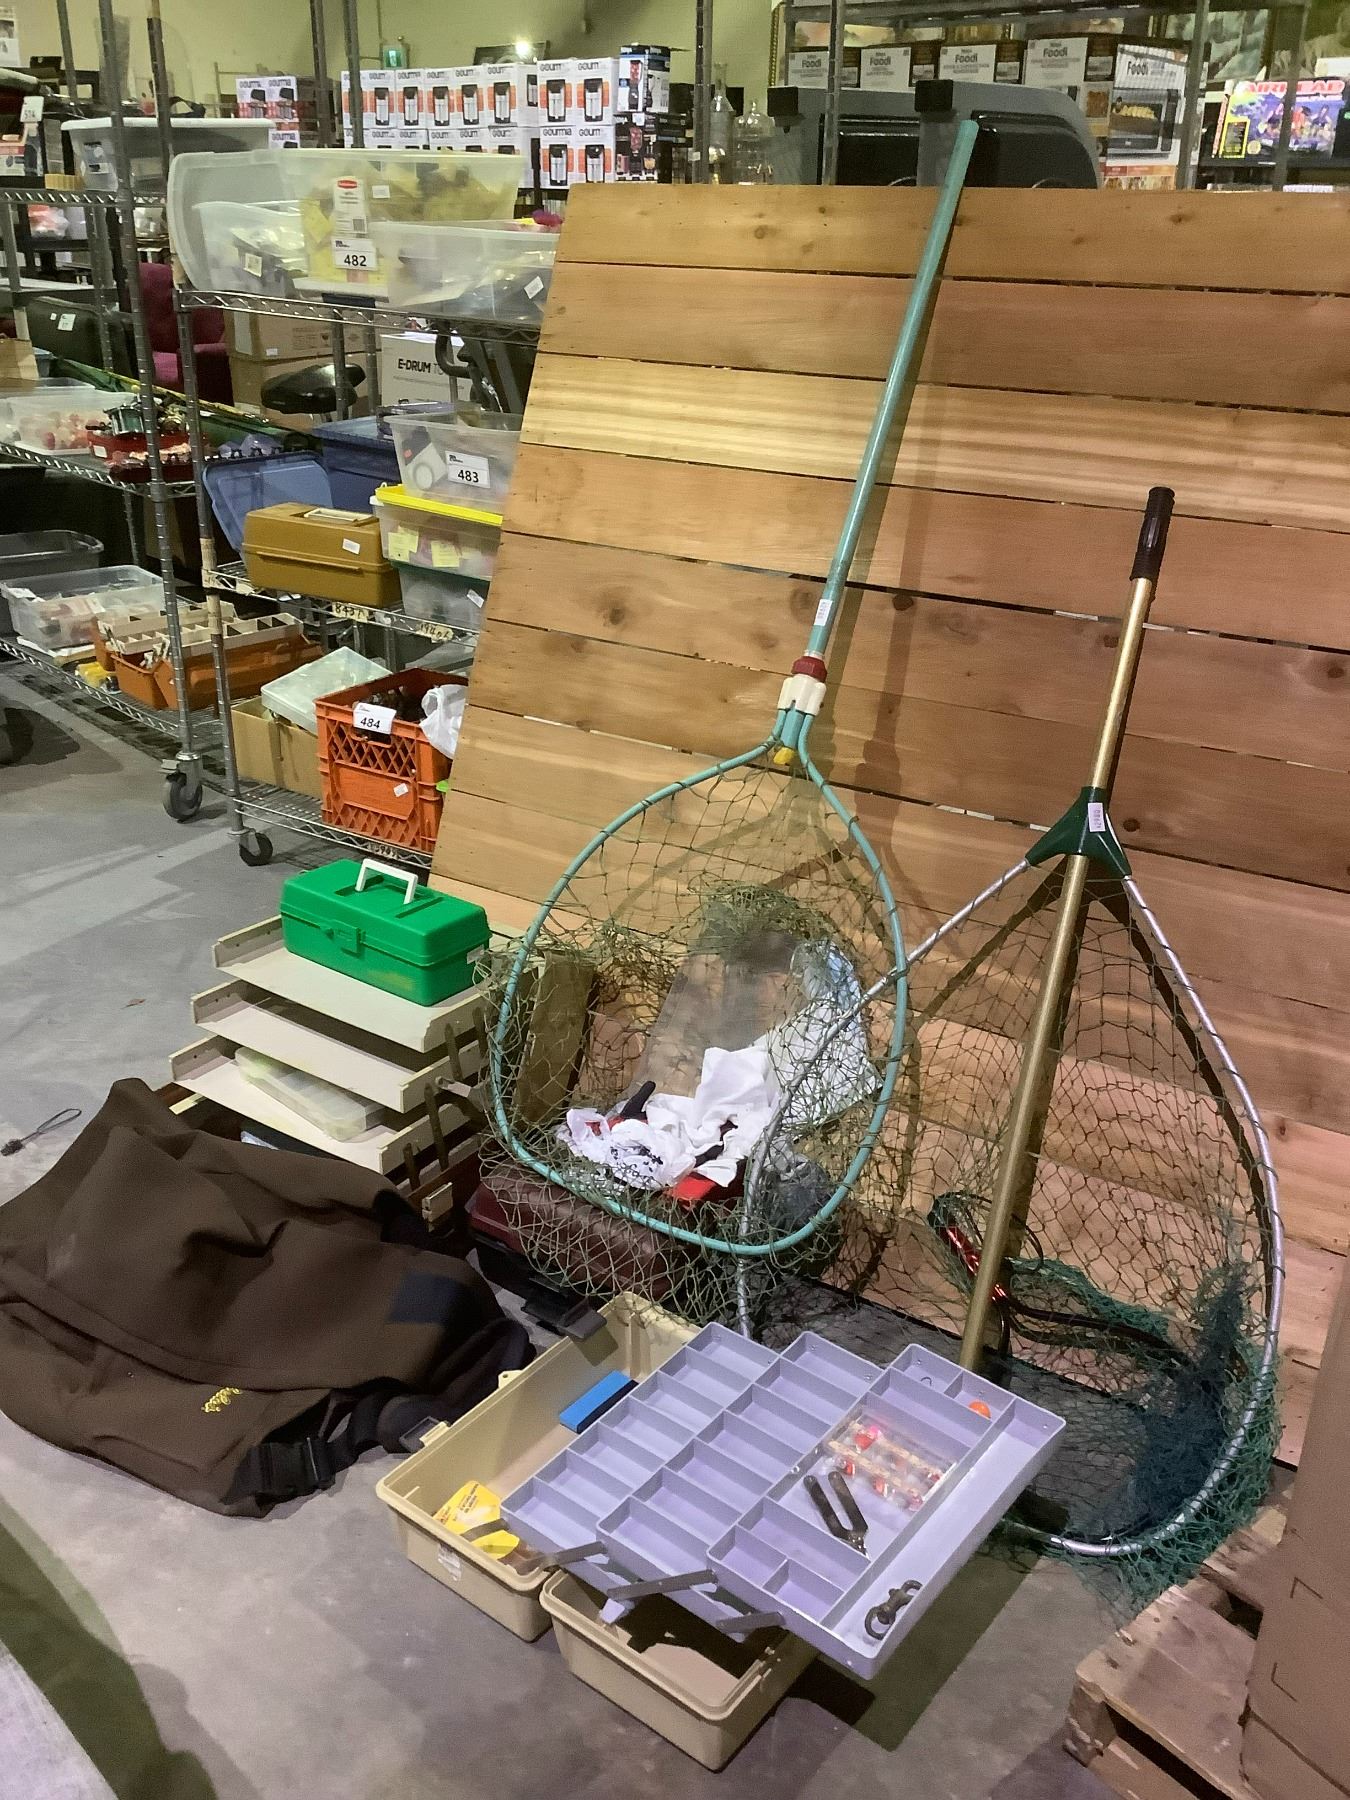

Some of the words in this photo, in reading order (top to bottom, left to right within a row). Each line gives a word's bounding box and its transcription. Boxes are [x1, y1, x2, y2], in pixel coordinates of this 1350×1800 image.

[955, 53, 978, 63] Foodi
[344, 254, 367, 267] 482
[398, 358, 431, 374] E-DRUM
[458, 469, 480, 483] 483
[360, 717, 381, 729] 484
